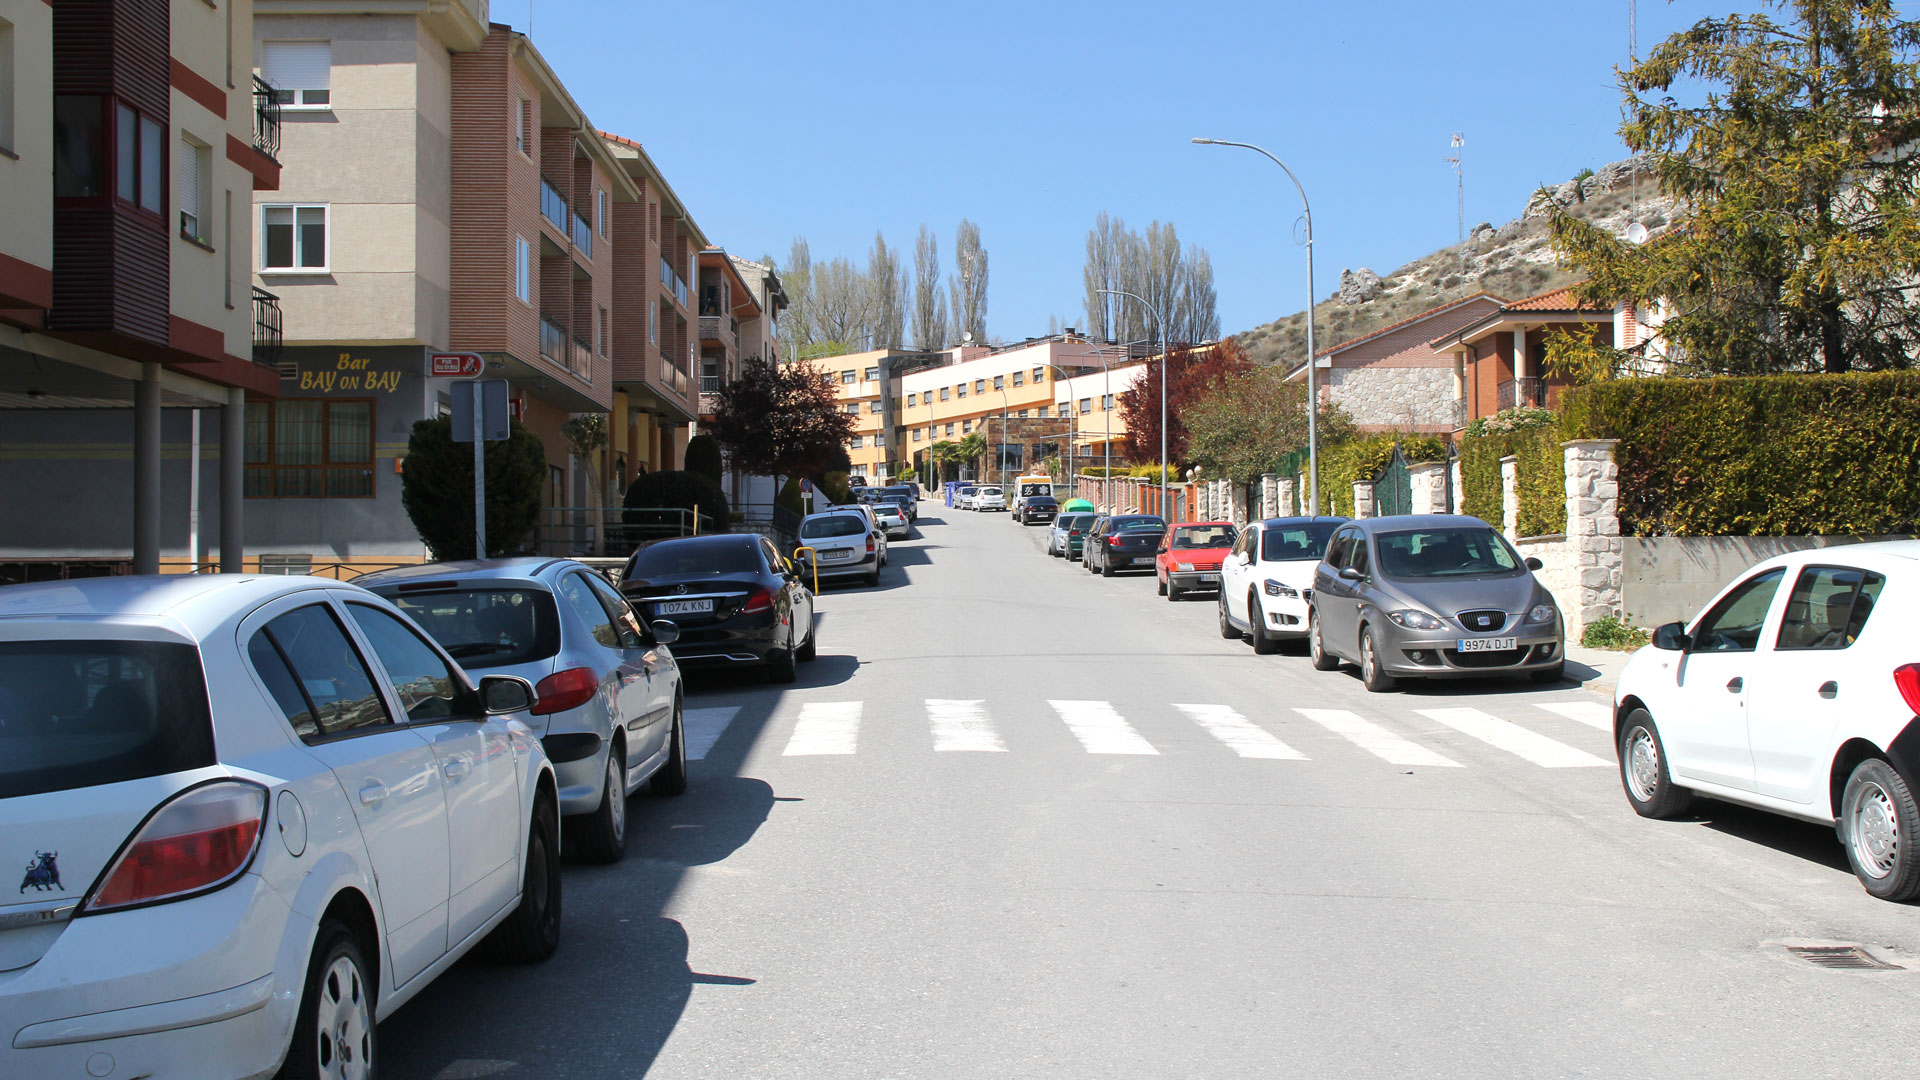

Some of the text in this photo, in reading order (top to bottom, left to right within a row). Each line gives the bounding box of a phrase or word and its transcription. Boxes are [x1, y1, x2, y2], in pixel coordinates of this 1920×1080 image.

[336, 352, 370, 370] Bar
[300, 370, 402, 393] BAY ON BAY
[663, 600, 711, 613] 1074 KNJ
[1465, 638, 1514, 651] 9974 DJT
